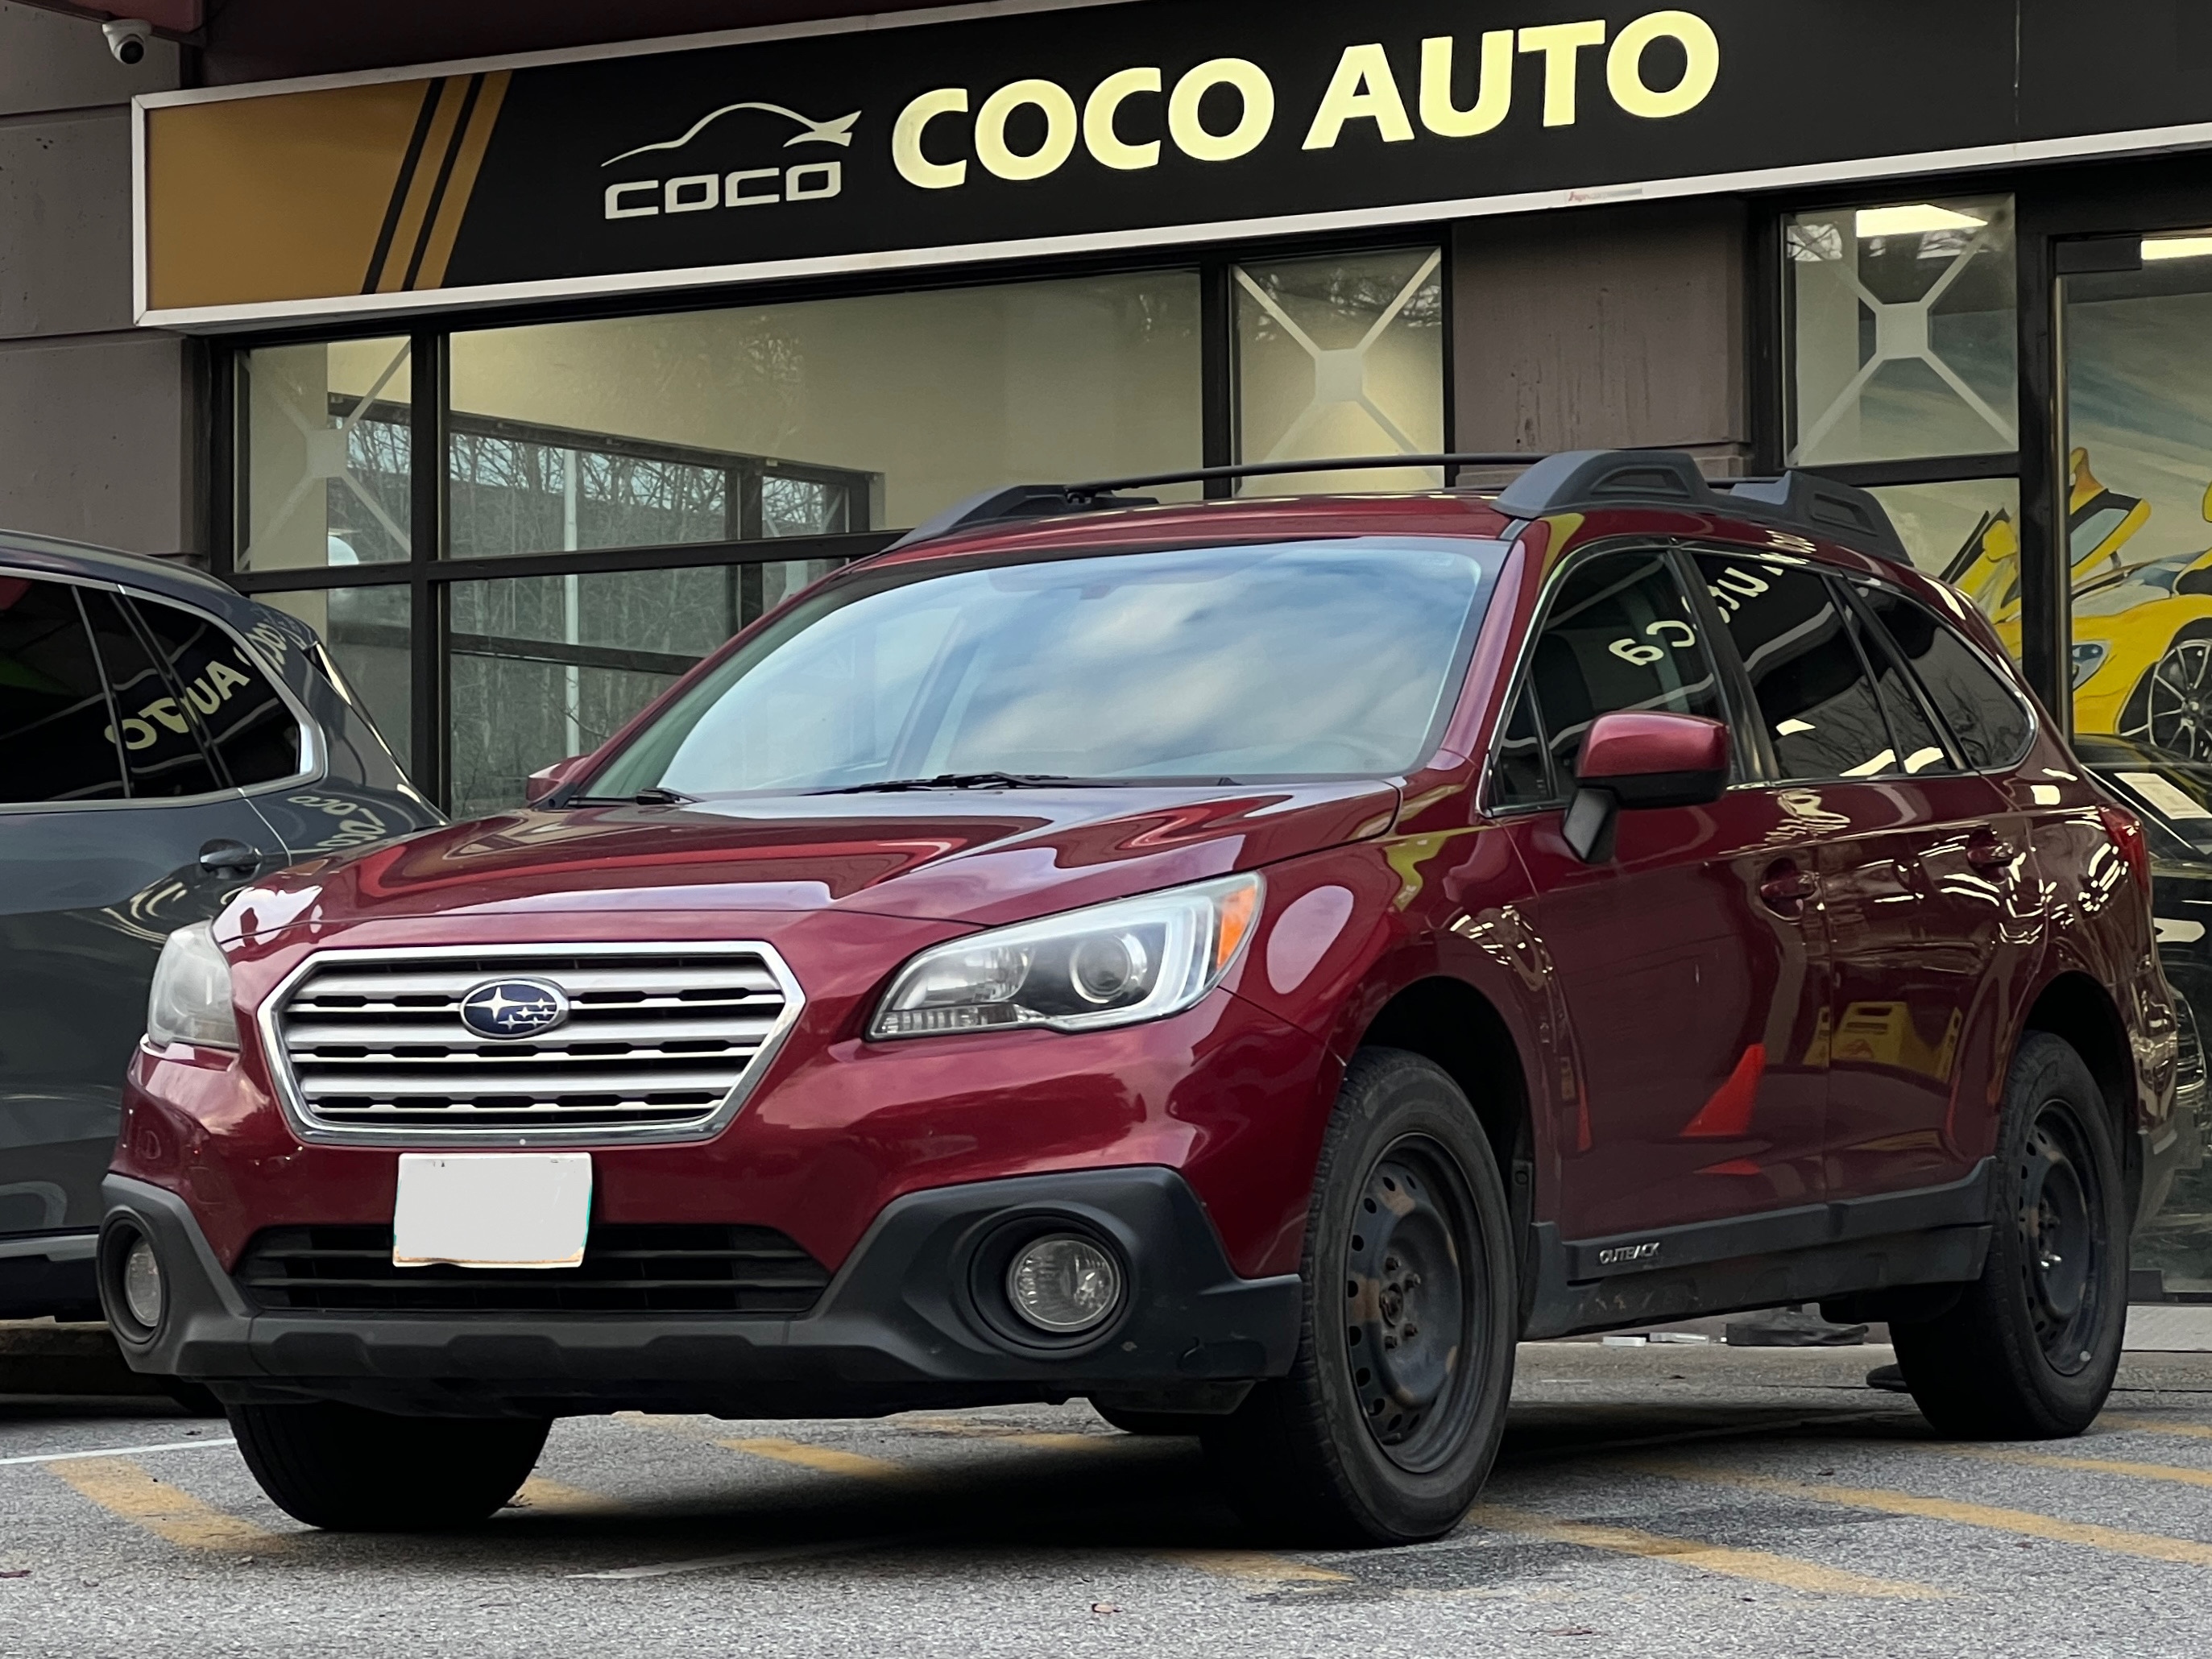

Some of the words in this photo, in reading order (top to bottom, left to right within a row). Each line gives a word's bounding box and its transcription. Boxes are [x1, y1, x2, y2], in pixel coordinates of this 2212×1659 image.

[892, 58, 1274, 189] COCO
[1302, 10, 1719, 150] AUTO
[605, 161, 841, 219] COCO
[1600, 1243, 1659, 1264] OUTBACK
